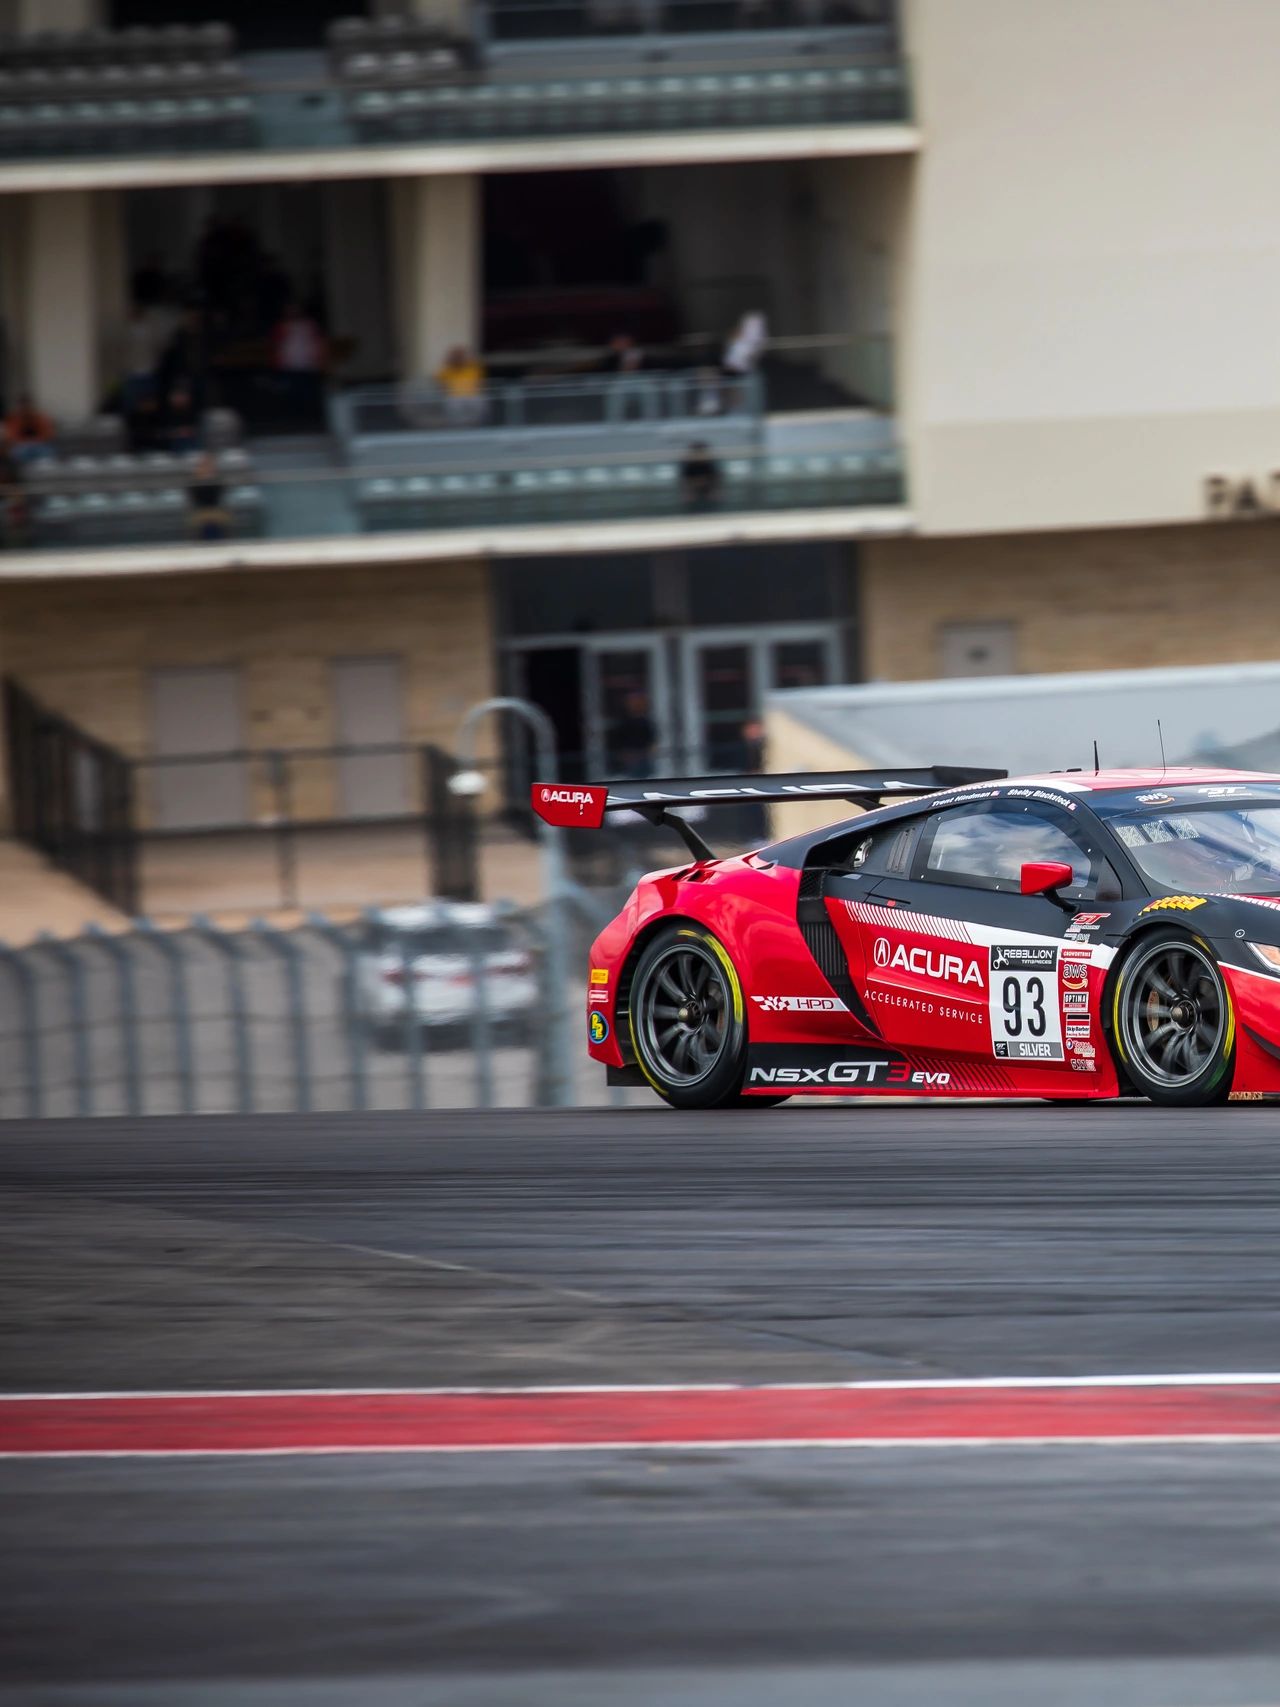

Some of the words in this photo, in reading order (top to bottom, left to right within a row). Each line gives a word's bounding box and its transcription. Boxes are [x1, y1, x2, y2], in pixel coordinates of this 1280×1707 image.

[550, 790, 594, 804] ACURA
[931, 797, 954, 807] Trent
[954, 791, 991, 802] Hindman
[1007, 789, 1034, 798] Shelby
[1033, 790, 1070, 807] Blackstock
[1136, 793, 1168, 801] aws
[1003, 949, 1053, 959] REBELLION
[890, 944, 985, 987] ACURA
[1063, 963, 1088, 979] aws
[796, 998, 835, 1010] HPD
[1065, 994, 1087, 1003] OPTIMA
[864, 989, 934, 1014] ACCELERATED
[940, 1006, 983, 1024] SERVICE
[1002, 976, 1047, 1037] 93
[1019, 1043, 1052, 1057] SILVER
[912, 1071, 951, 1085] EVO
